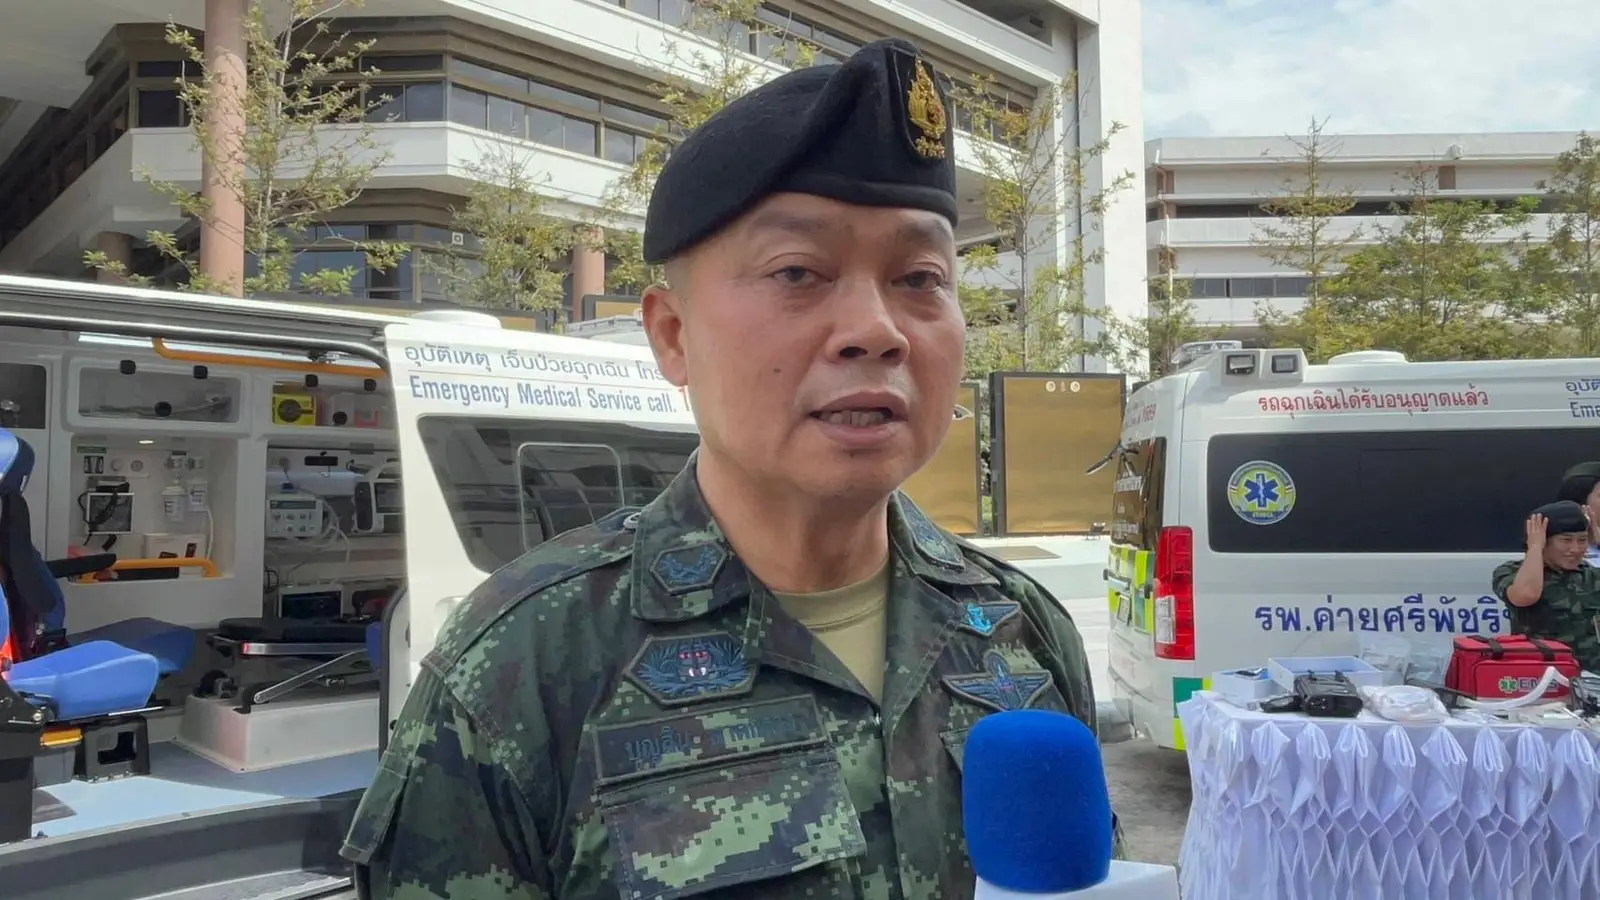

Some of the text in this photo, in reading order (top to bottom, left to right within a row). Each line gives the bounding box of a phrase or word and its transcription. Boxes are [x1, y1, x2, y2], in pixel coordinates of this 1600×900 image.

[404, 343, 492, 372] อุบัติเหตุ
[501, 349, 630, 380] เจ็บป่วยฉุกเฉิน
[409, 375, 509, 409] Emergency
[517, 382, 582, 409] Medical
[587, 387, 641, 412] Service
[647, 392, 678, 413] call.
[1258, 383, 1489, 419] รถฉุกเฉินได้รับอนุญาตแล้ว
